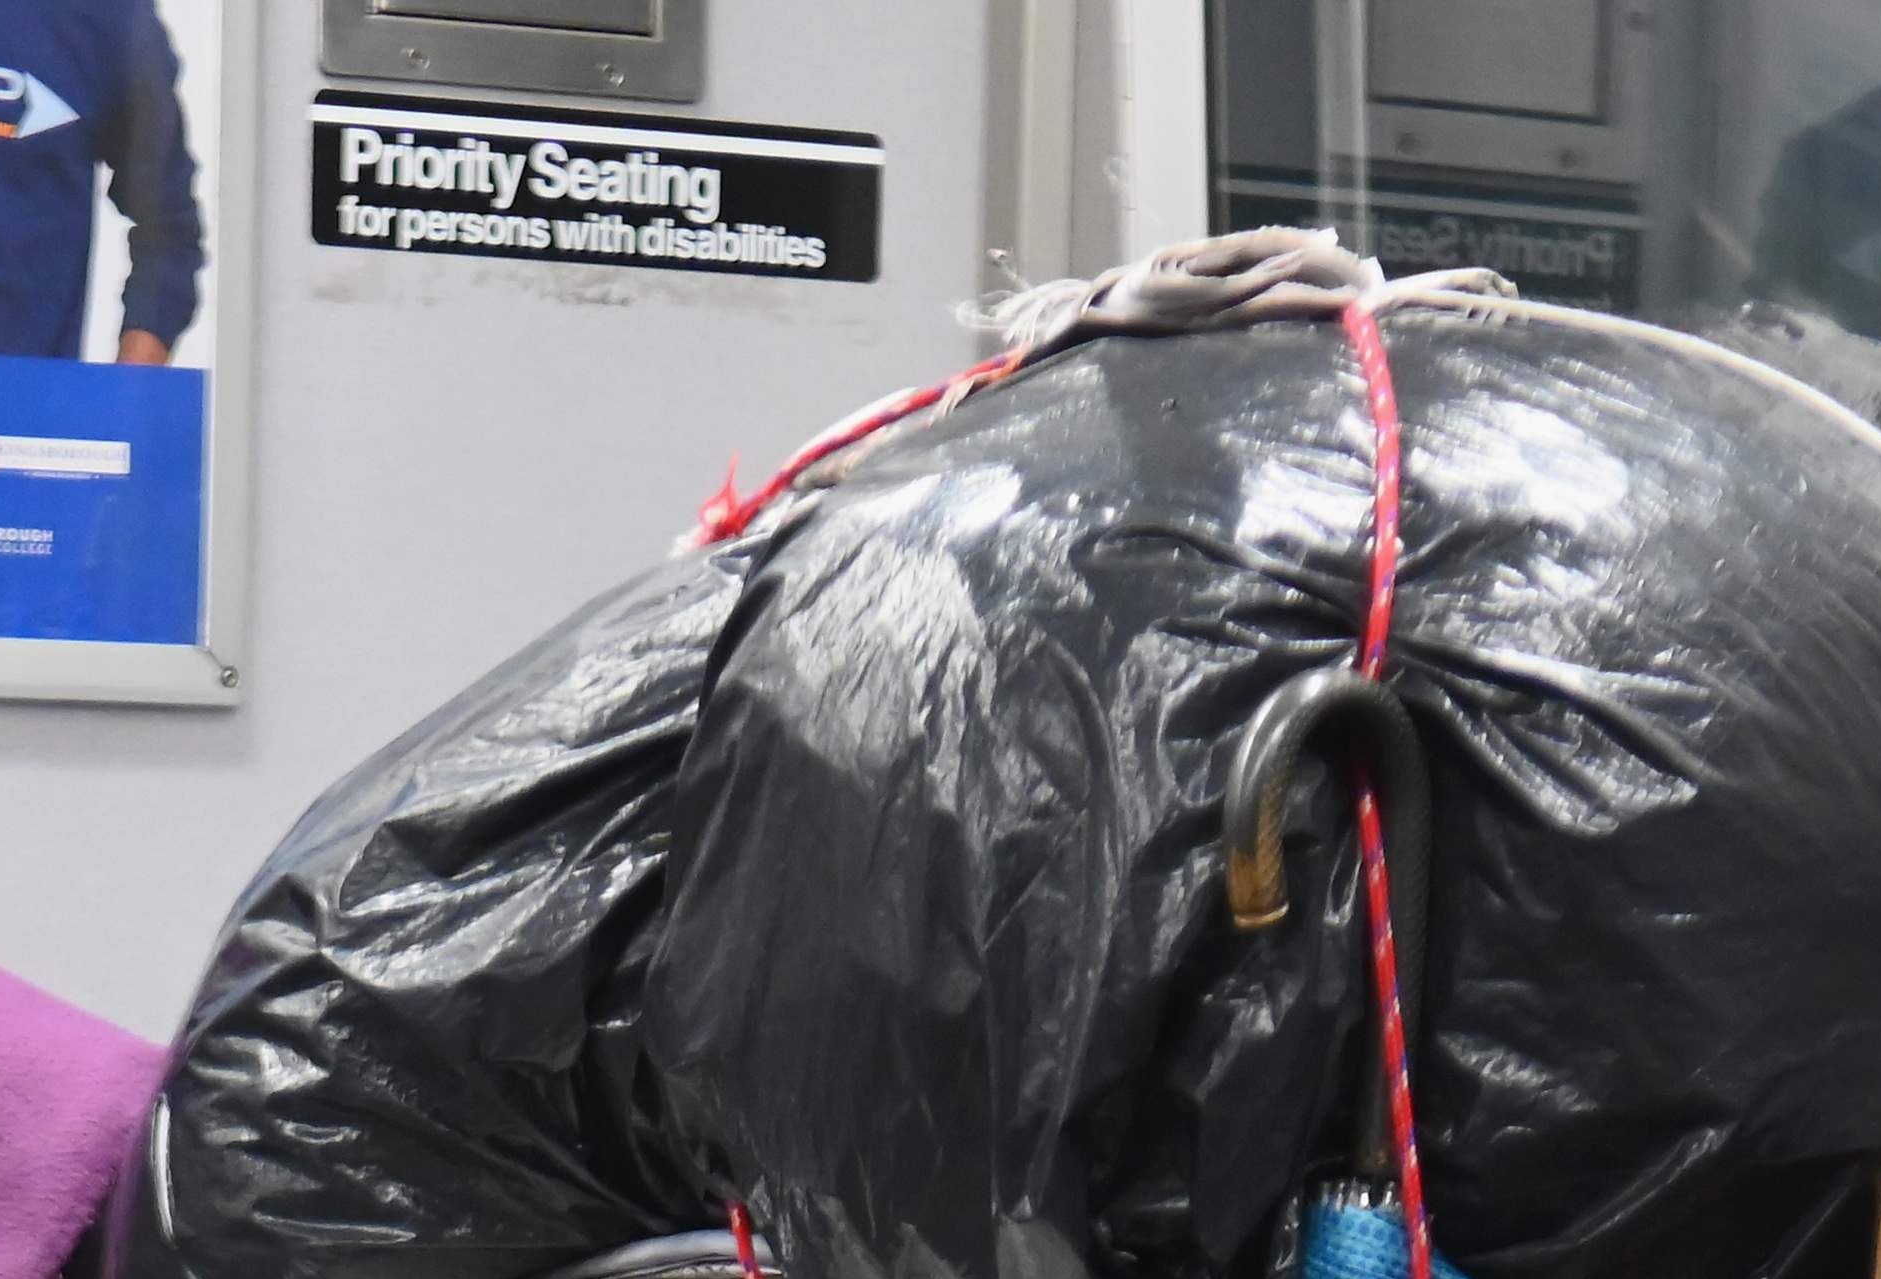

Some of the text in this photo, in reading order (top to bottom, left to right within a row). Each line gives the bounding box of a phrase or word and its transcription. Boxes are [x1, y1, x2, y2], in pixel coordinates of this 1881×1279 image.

[338, 127, 722, 223] Priority Seating
[336, 196, 827, 269] for persons with disabilities
